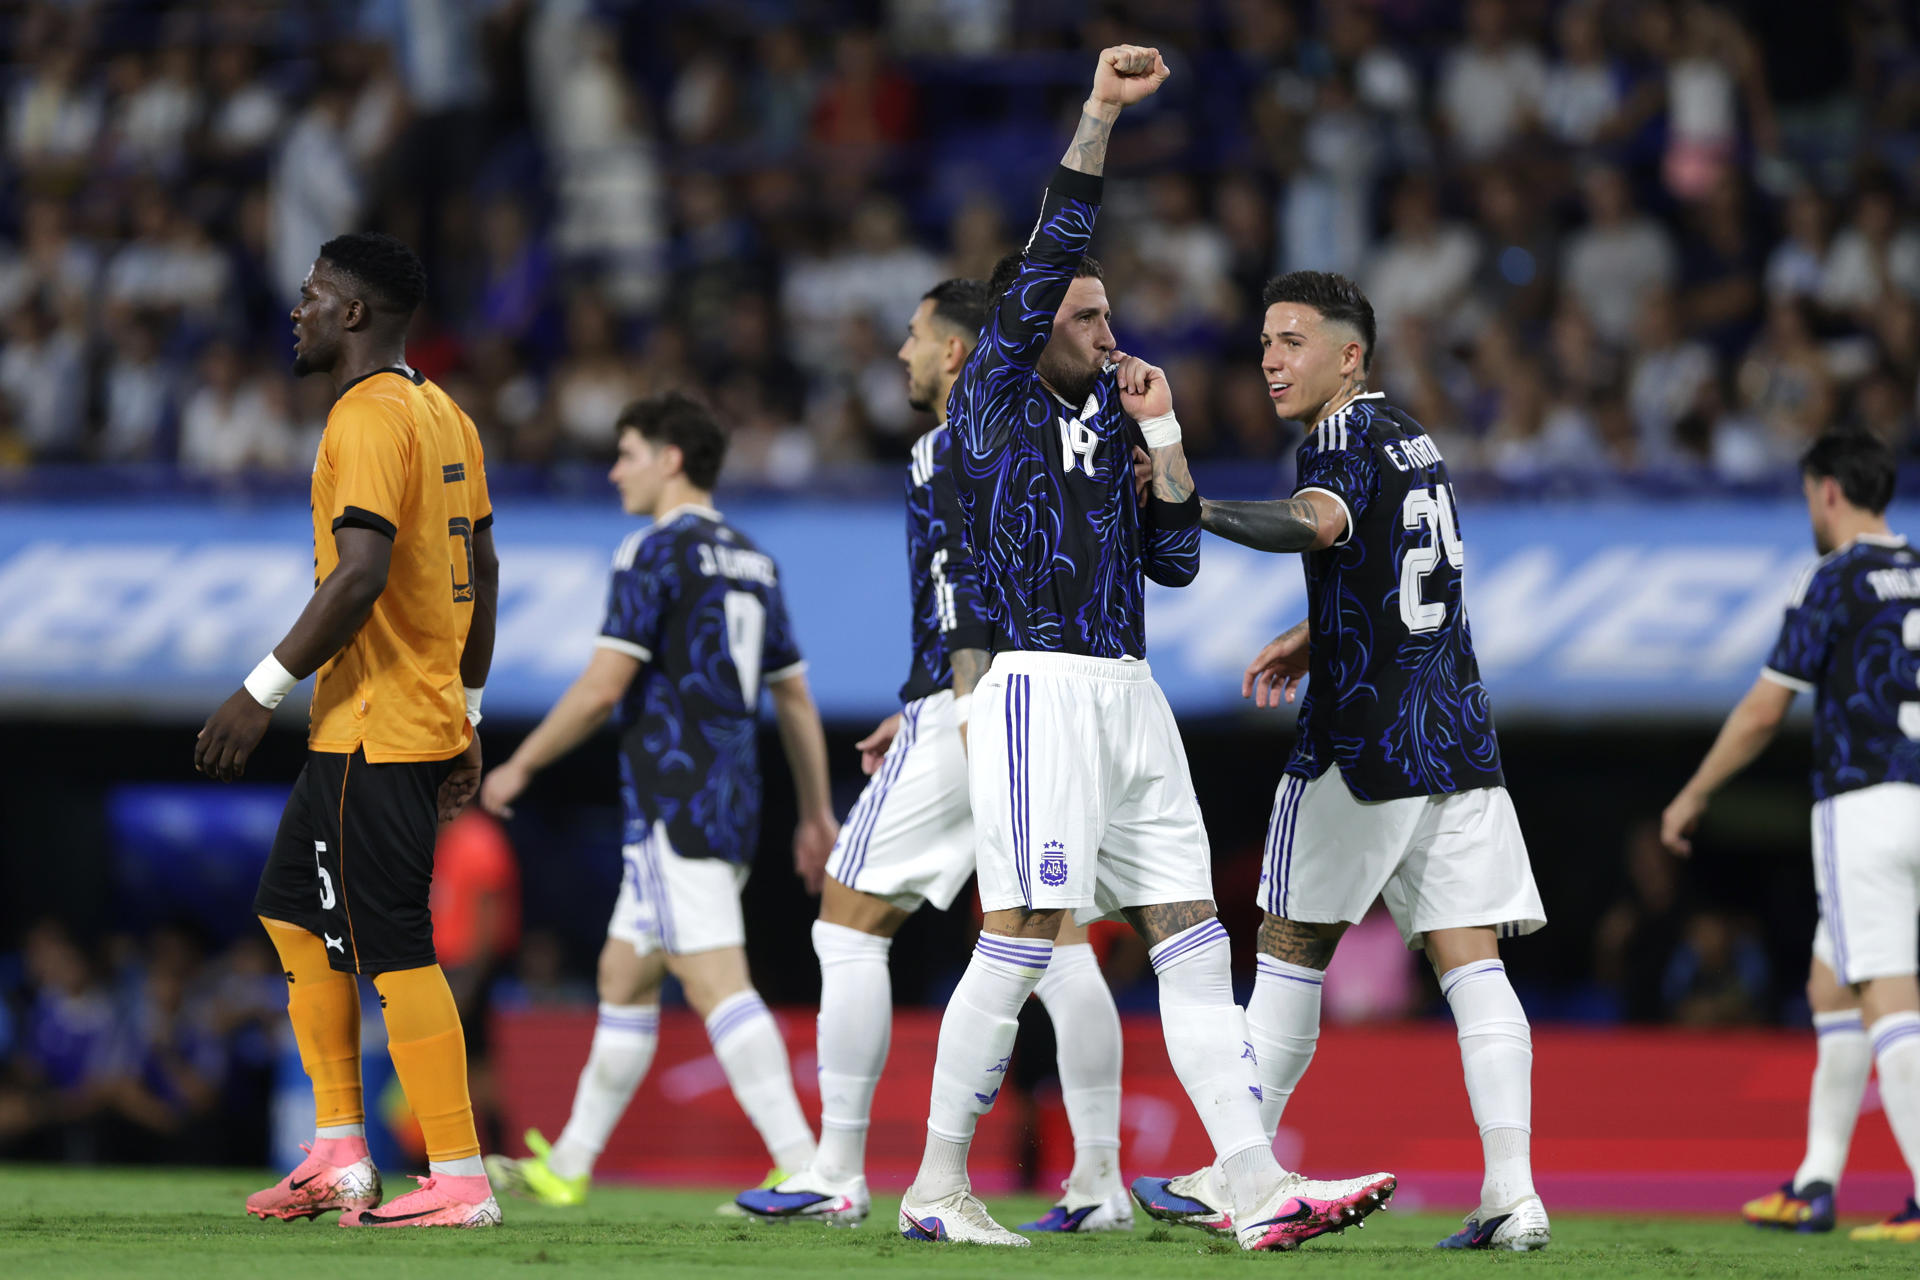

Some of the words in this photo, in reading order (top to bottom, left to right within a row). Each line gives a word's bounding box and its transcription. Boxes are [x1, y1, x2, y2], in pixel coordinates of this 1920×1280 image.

[1058, 416, 1098, 477] 19
[1400, 482, 1465, 634] 24
[724, 590, 766, 714] 9
[314, 840, 336, 910] 5
